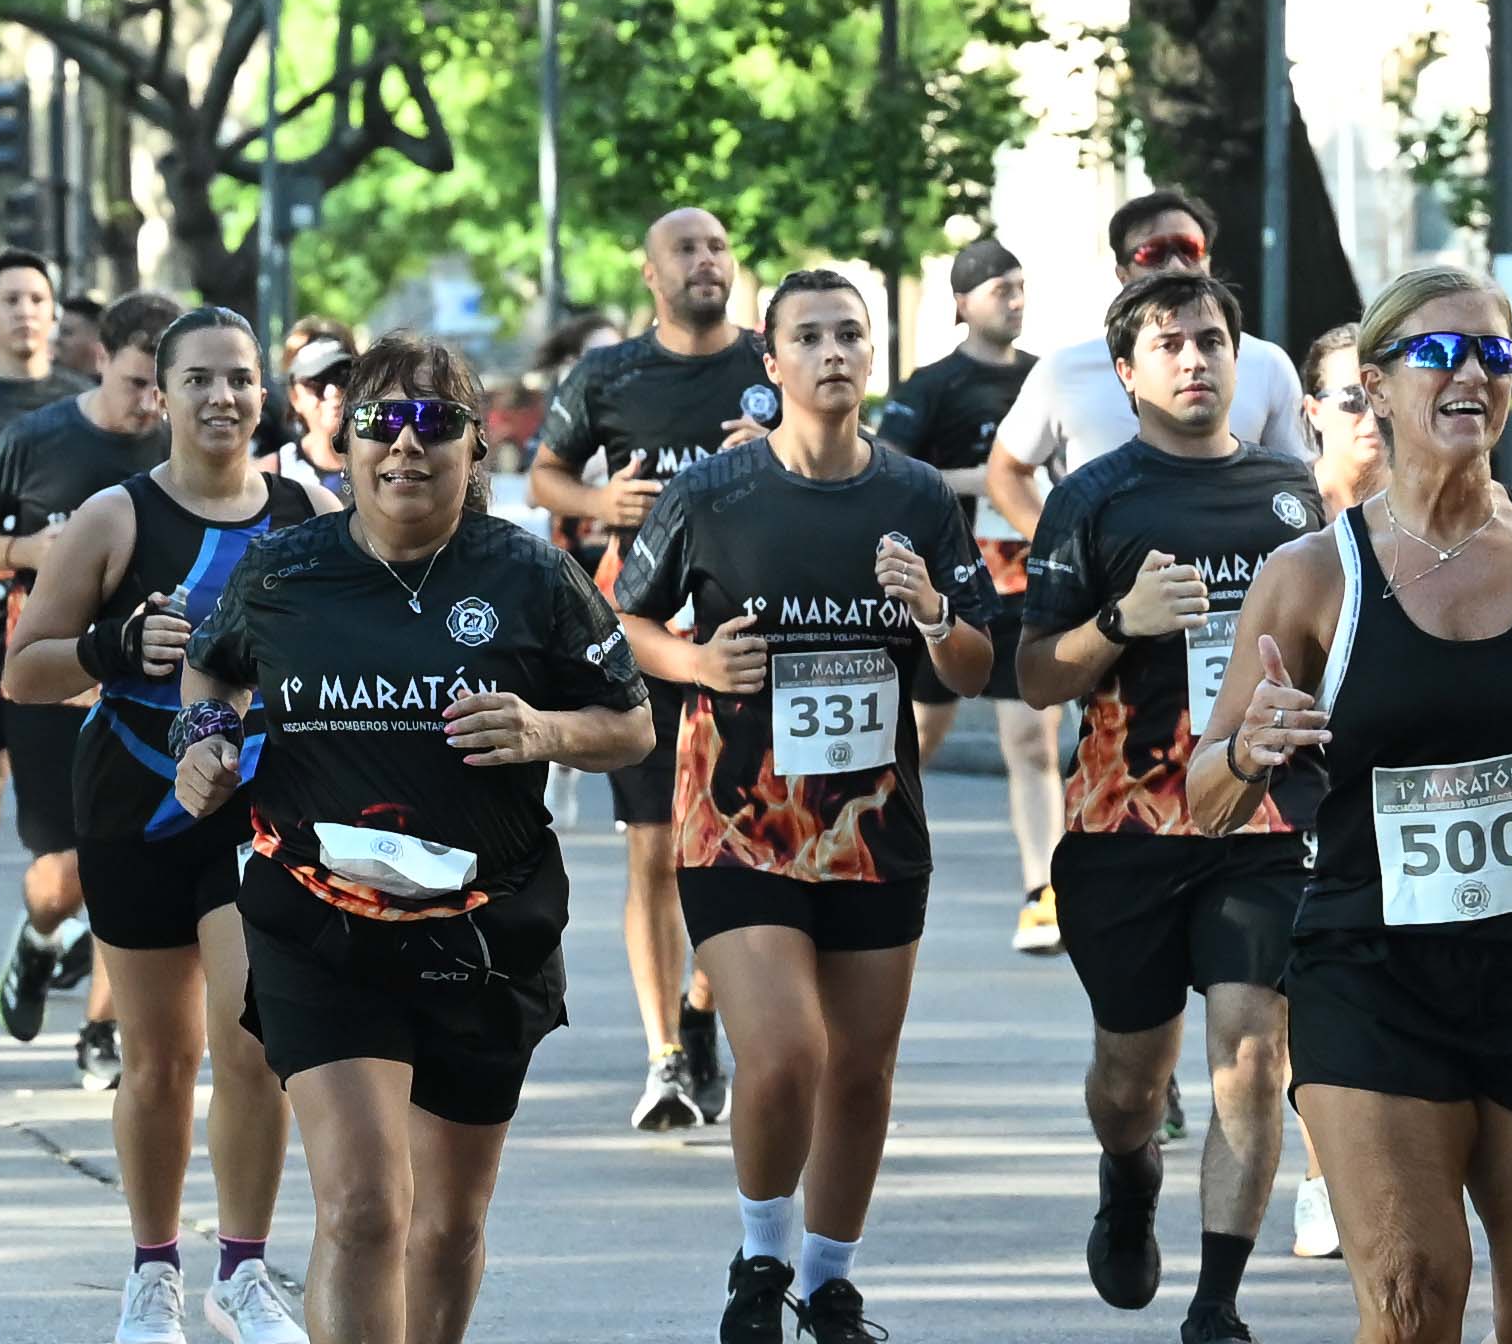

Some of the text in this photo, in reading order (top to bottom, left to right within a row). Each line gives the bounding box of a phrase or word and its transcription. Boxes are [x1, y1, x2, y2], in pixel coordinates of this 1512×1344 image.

[1193, 552, 1273, 584] MARA
[810, 654, 887, 678] MARATÓN
[330, 720, 389, 732] BOMBEROS
[789, 692, 884, 739] 331
